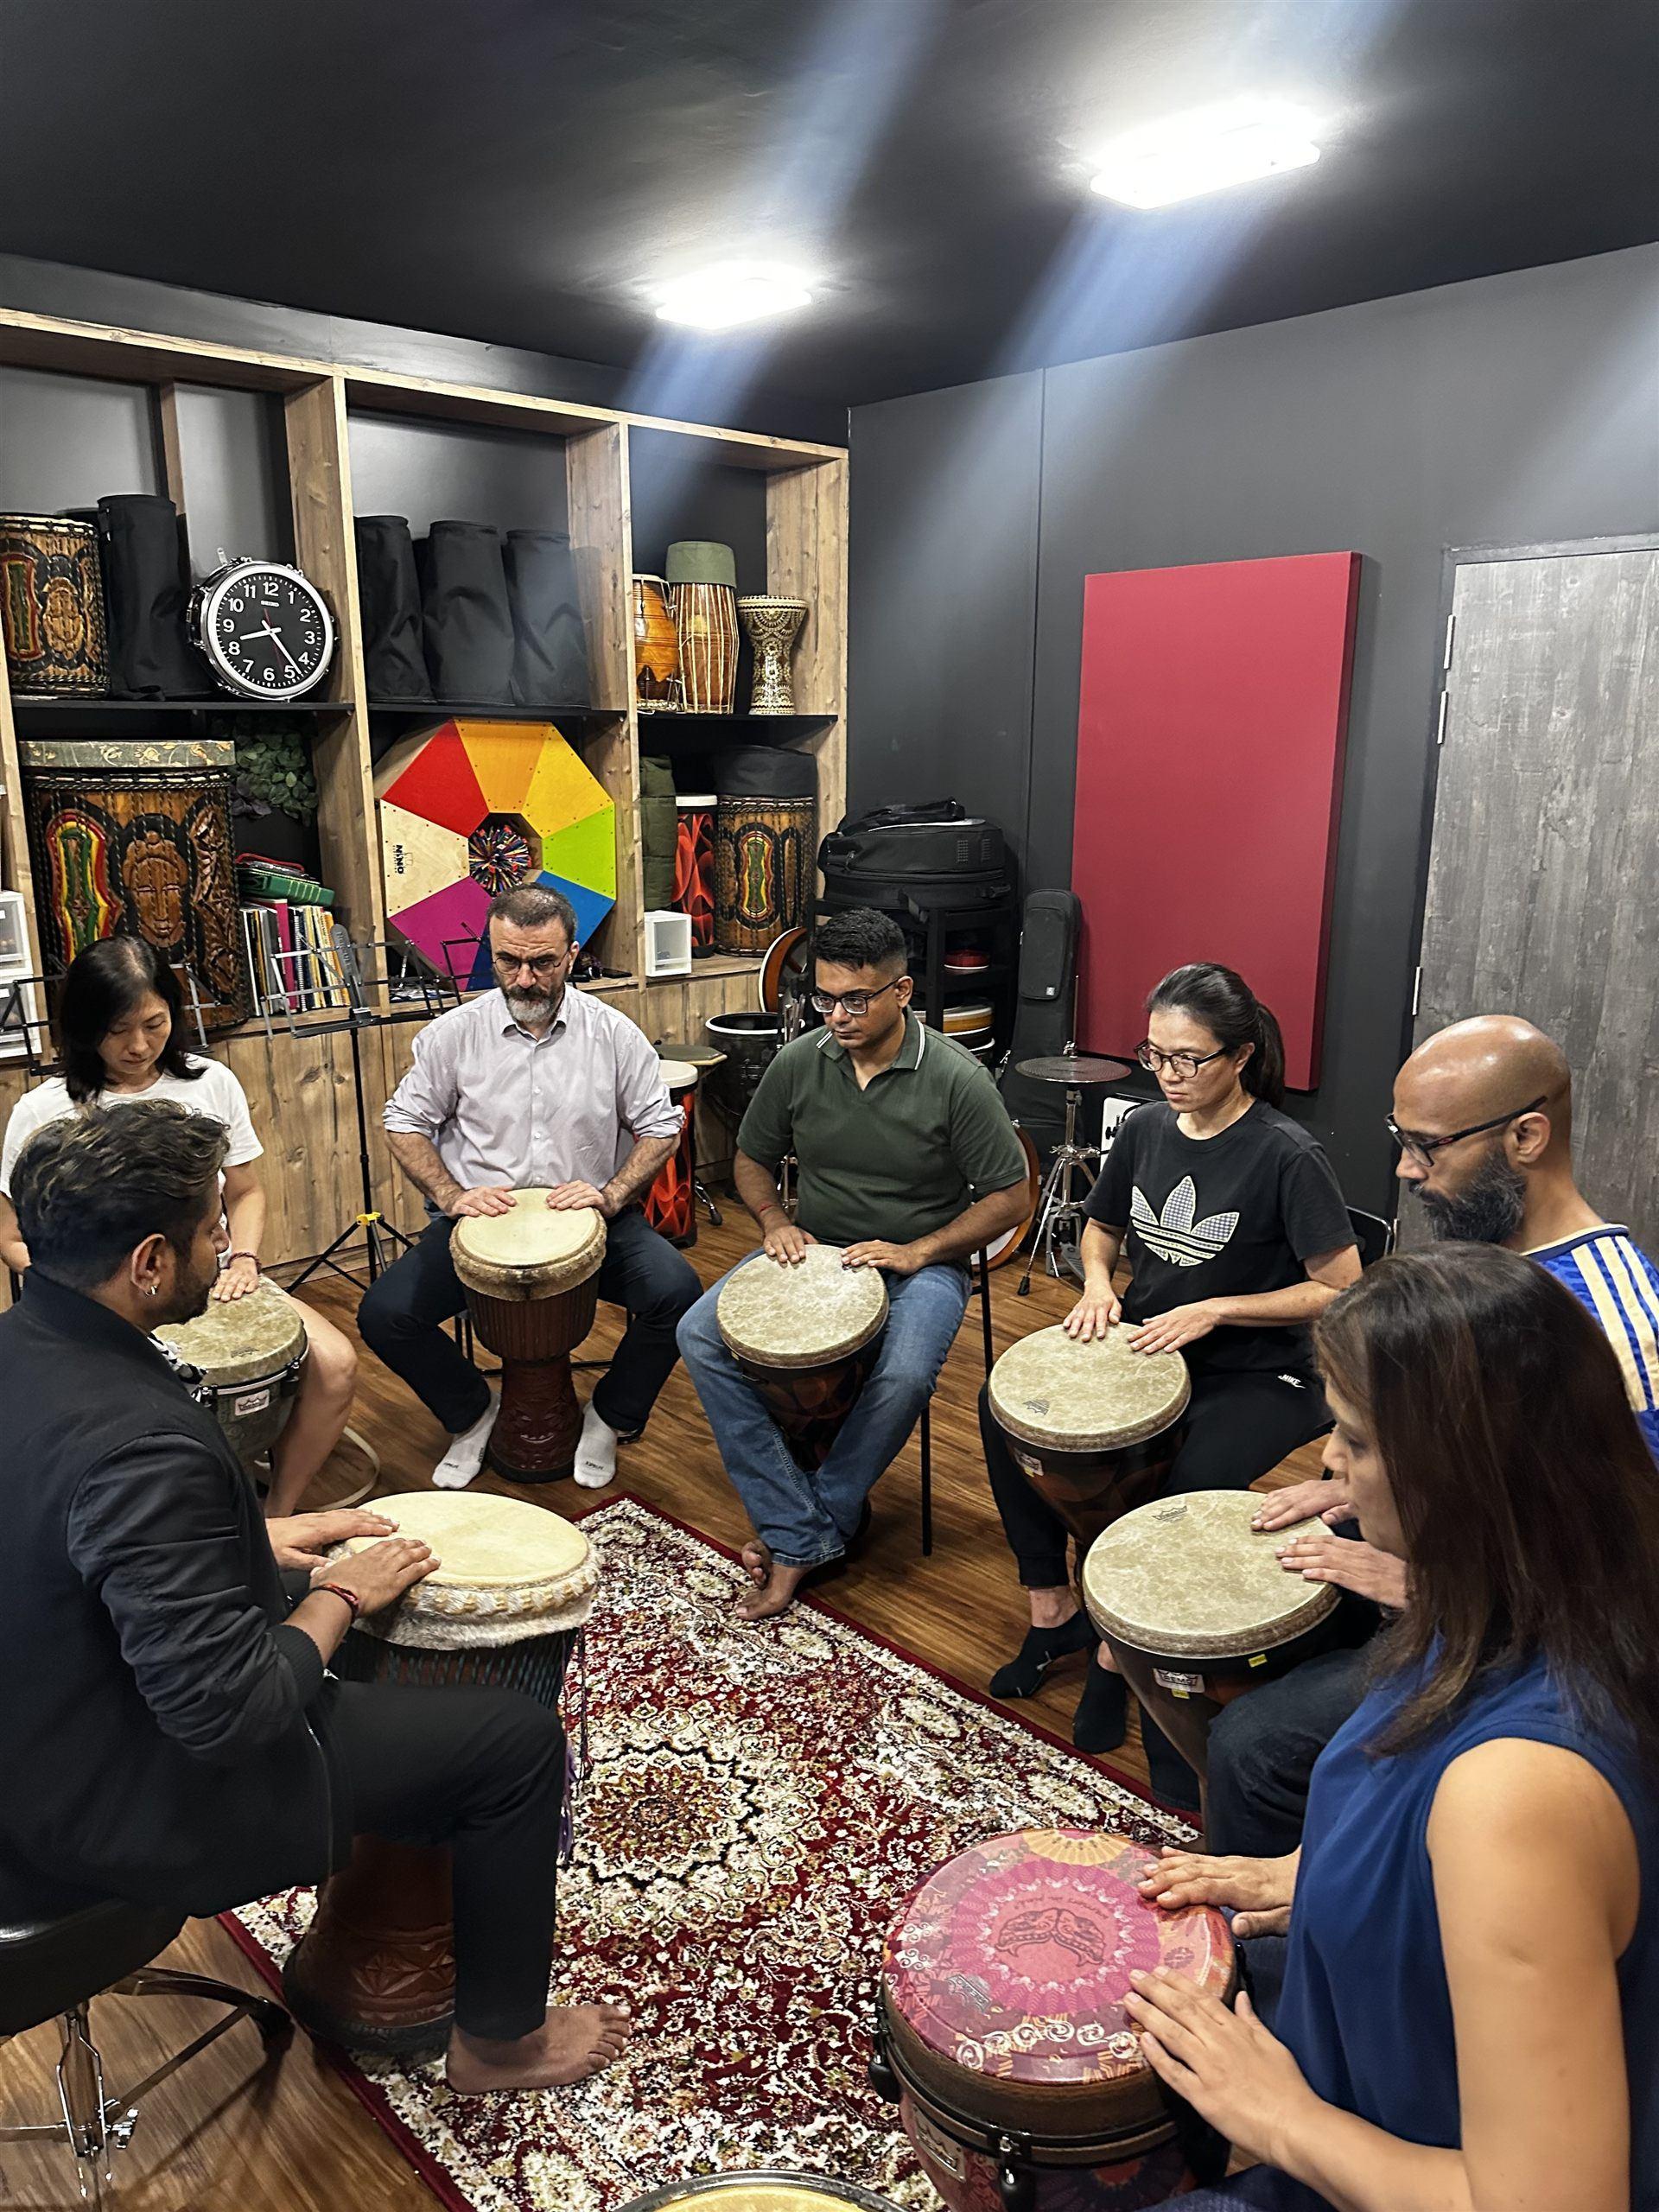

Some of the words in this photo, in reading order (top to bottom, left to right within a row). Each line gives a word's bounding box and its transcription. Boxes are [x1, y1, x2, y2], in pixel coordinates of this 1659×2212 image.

[243, 584, 257, 599] 11
[263, 581, 279, 597] 12
[288, 590, 295, 605] 1
[228, 598, 245, 613] 10
[299, 608, 311, 623] 2
[222, 618, 235, 633] 9
[303, 630, 315, 645] 3
[228, 640, 241, 656] 8
[243, 658, 254, 673] 7
[298, 652, 310, 665] 4
[263, 667, 276, 682] 6
[283, 664, 296, 679] 5
[395, 844, 404, 874] NINO
